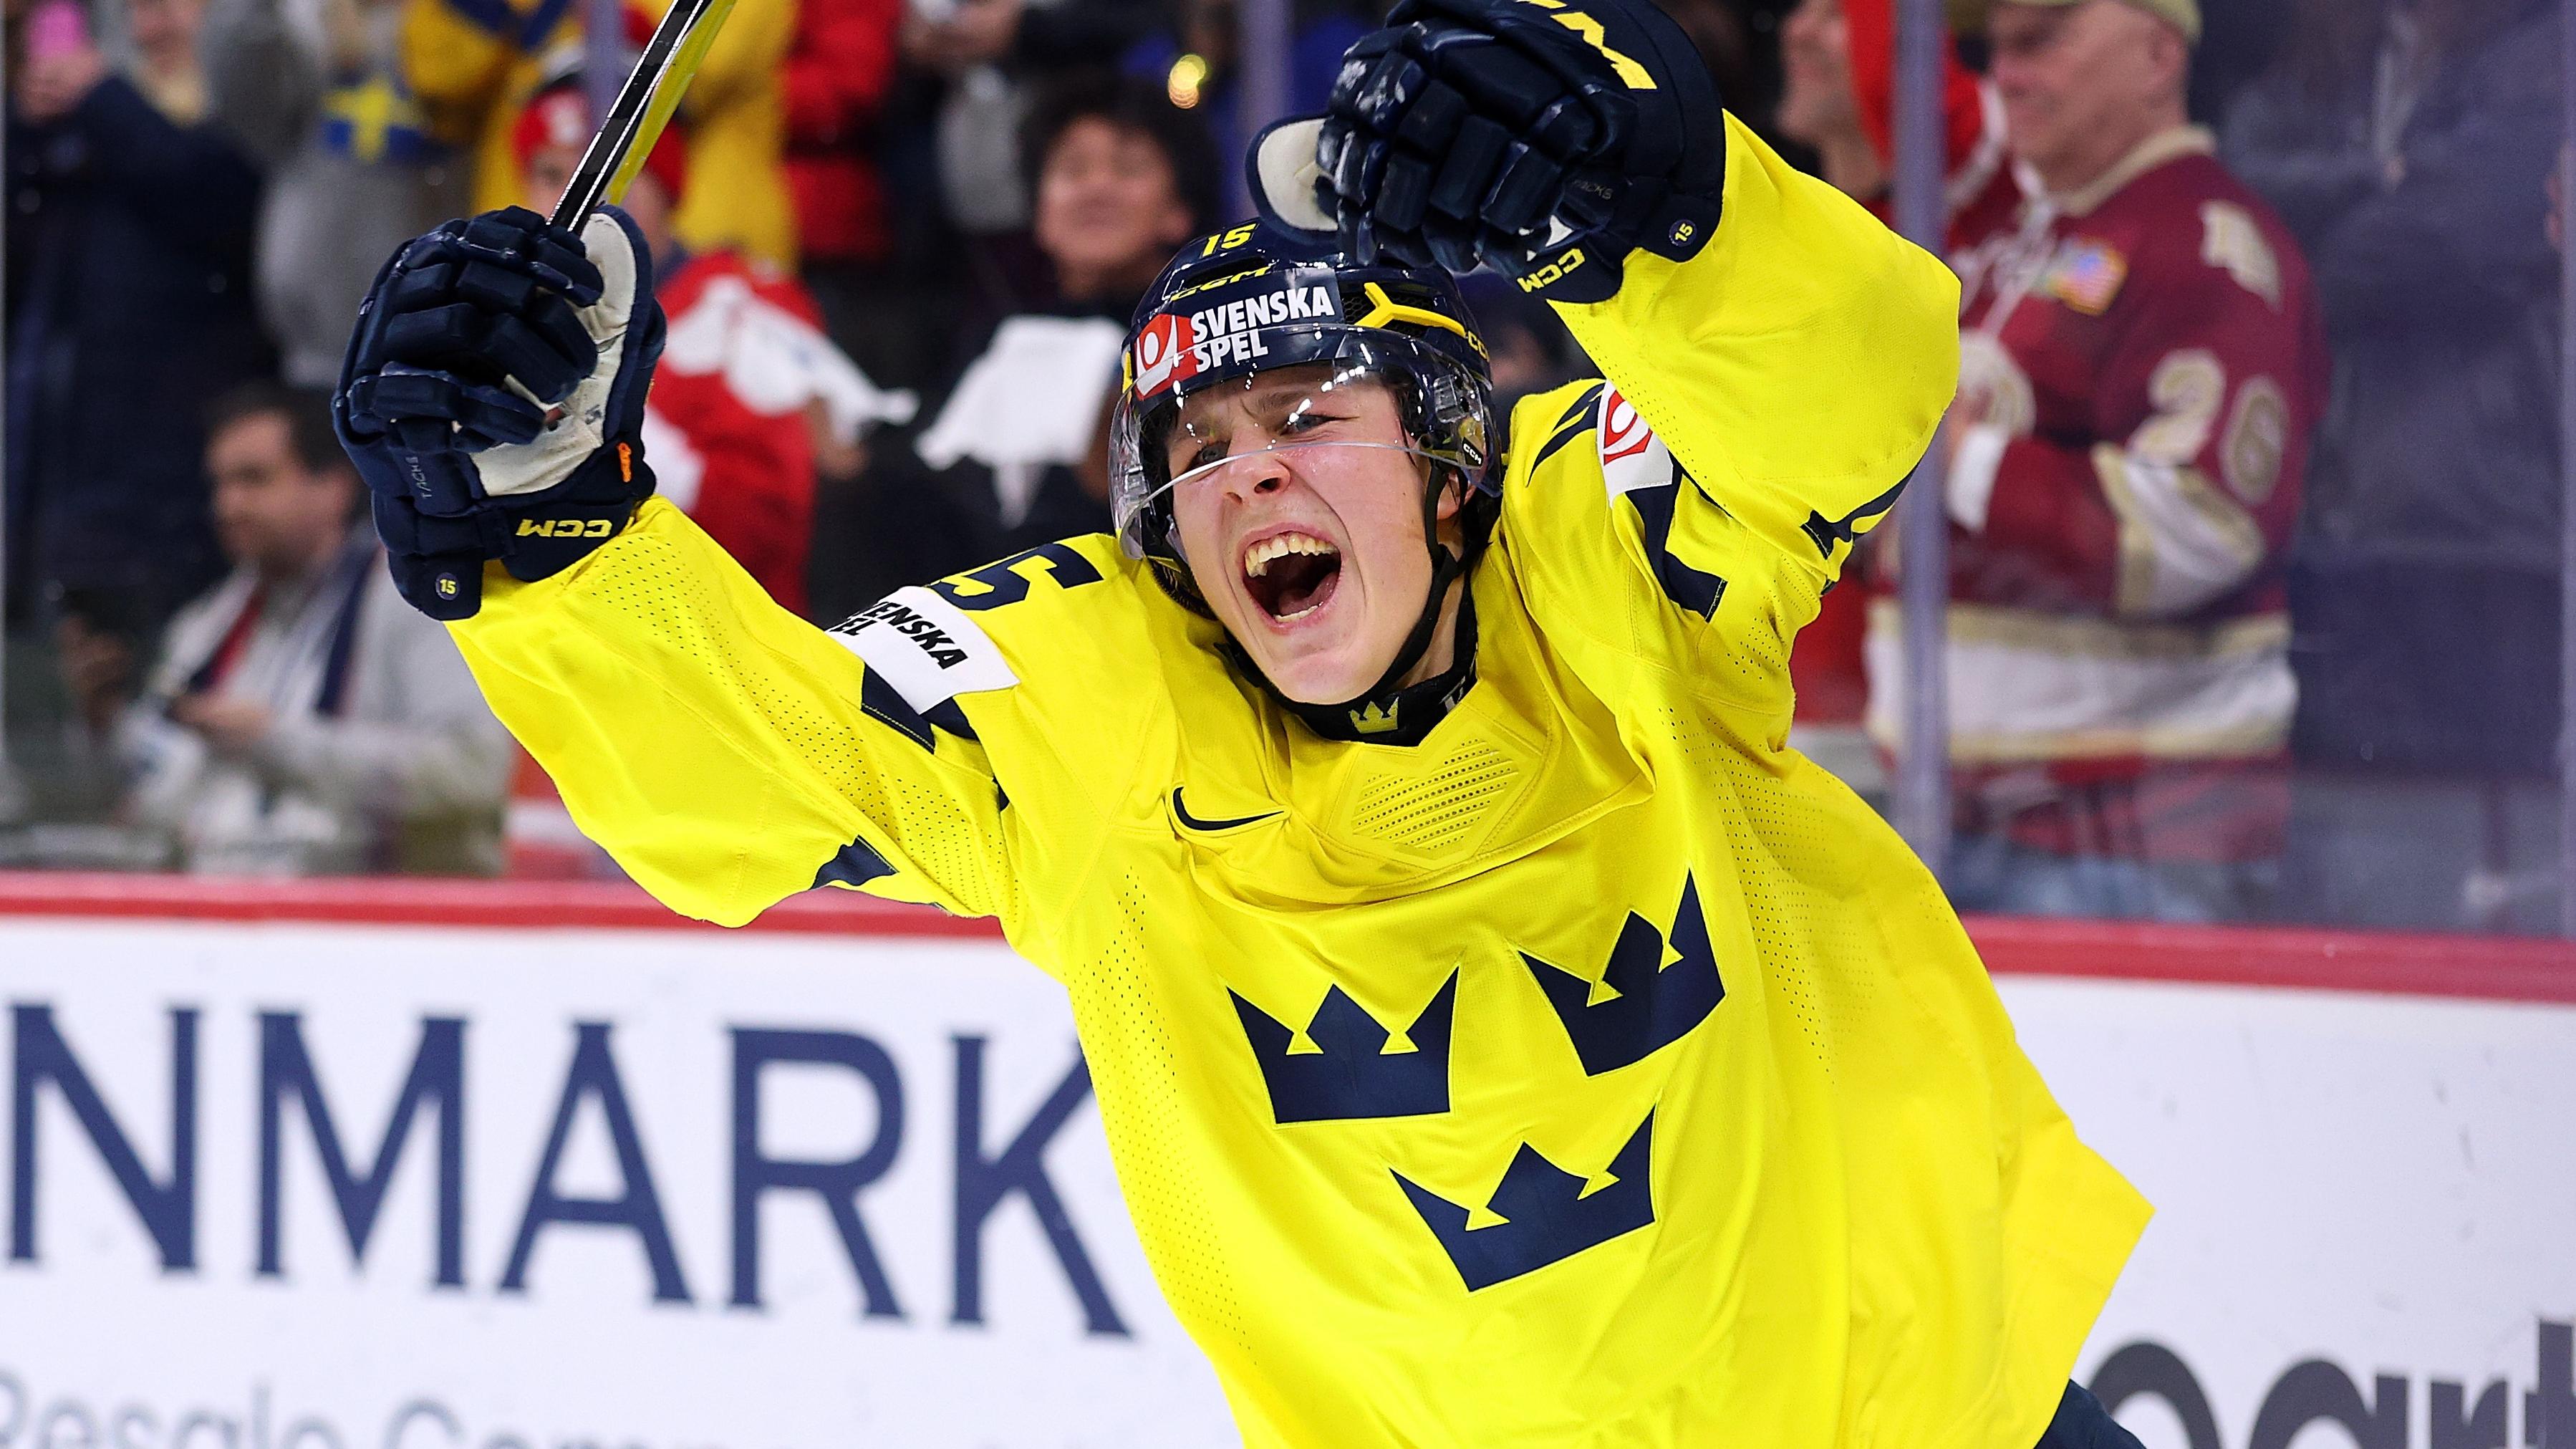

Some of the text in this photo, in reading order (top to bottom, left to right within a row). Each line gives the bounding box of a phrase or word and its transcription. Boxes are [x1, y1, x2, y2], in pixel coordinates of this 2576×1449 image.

[1202, 223, 1257, 257] 15
[1674, 223, 1694, 242] 15
[1517, 249, 1586, 293] CCM
[1190, 287, 1336, 344] SVENSKA
[1194, 328, 1268, 373] SPEL
[1468, 330, 1490, 362] CC
[1462, 443, 1482, 466] CCM
[515, 519, 613, 538] CCM
[439, 578, 457, 595] 15
[849, 602, 969, 670] ENSKA
